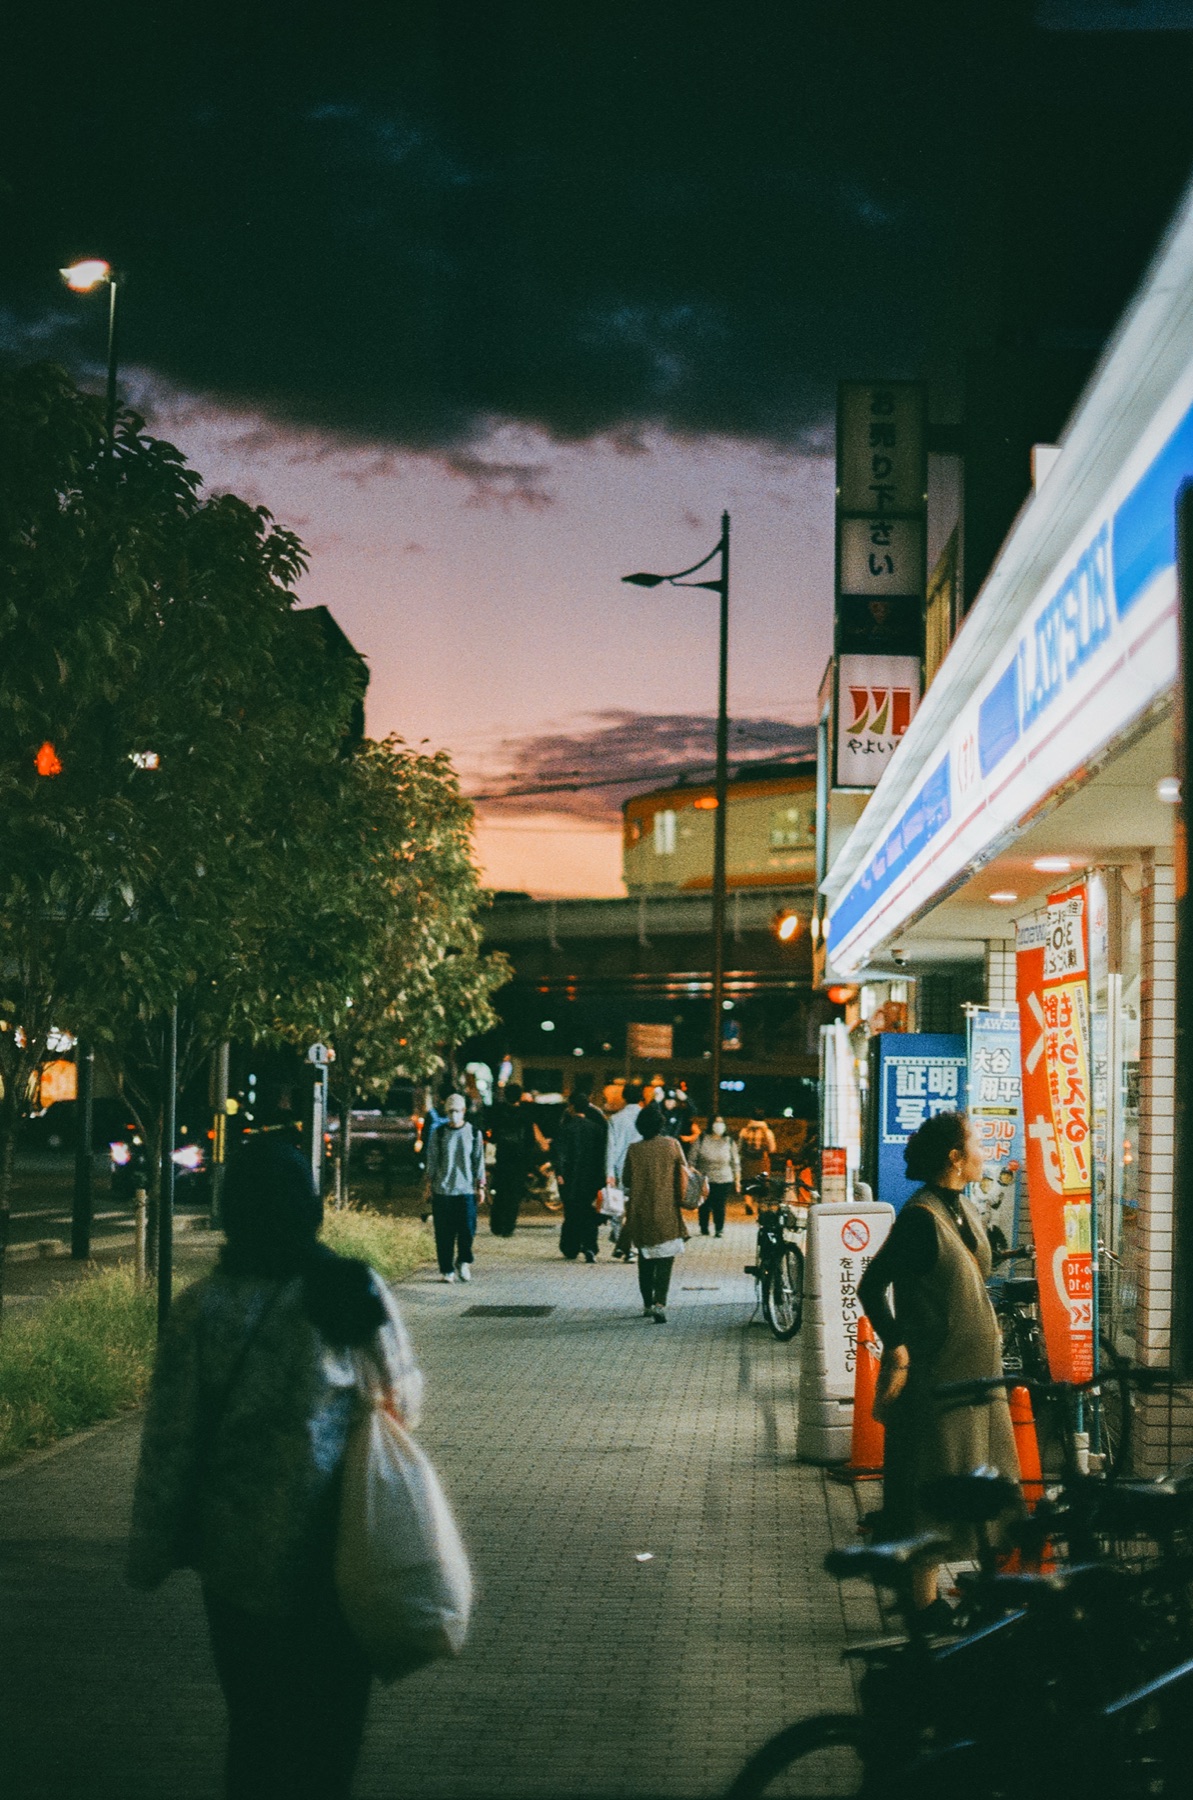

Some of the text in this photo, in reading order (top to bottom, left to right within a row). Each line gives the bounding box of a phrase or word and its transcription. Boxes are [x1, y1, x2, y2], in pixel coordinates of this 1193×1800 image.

[1017, 535, 1115, 733] LAWSON
[847, 738, 901, 755] やよい
[974, 1018, 1021, 1035] LAWSO
[974, 1047, 1012, 1074] 大谷
[896, 1066, 958, 1097] 証明
[981, 1075, 1021, 1102] 翔平
